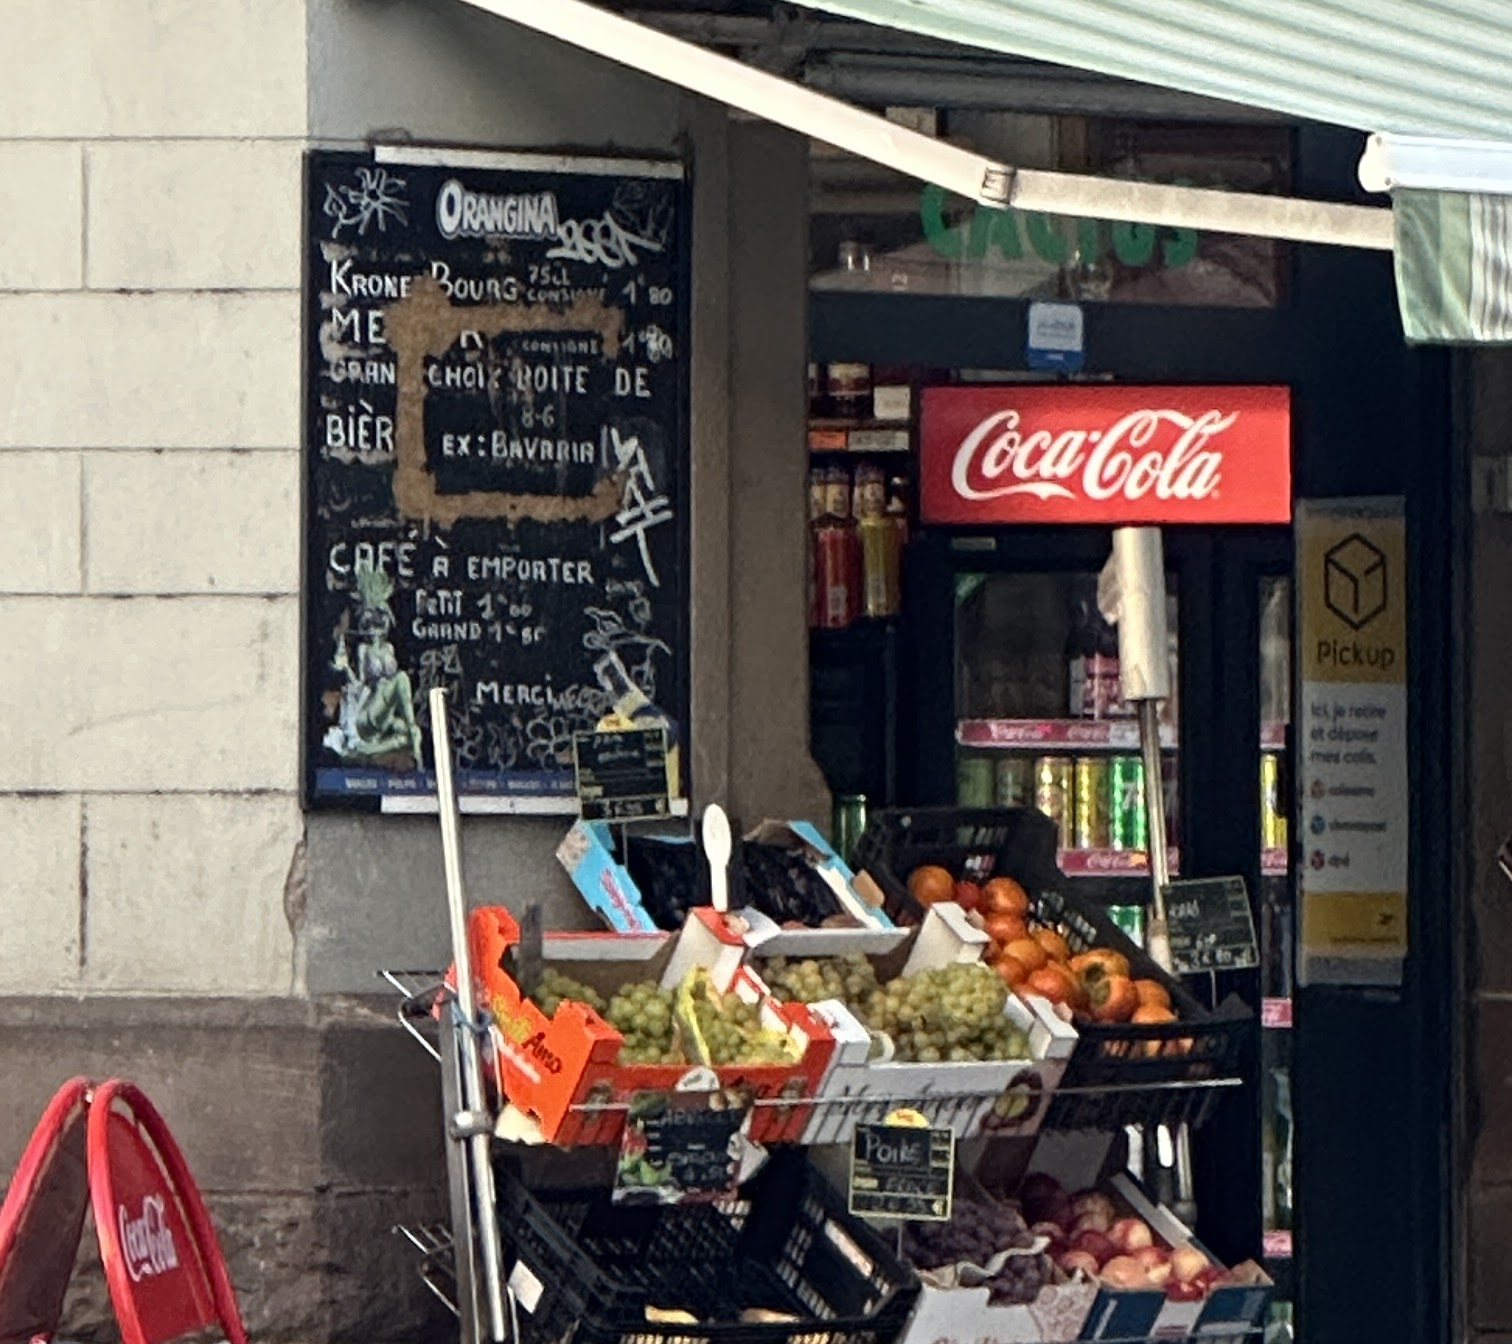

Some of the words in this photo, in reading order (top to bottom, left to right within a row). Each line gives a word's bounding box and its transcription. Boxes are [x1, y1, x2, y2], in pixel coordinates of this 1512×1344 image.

[436, 179, 559, 240] ORANGINA
[614, 367, 652, 398] DE
[950, 408, 1238, 501] Coca-Cola
[467, 556, 595, 585] EMPORTER
[1316, 638, 1395, 672] Pickup
[117, 1193, 180, 1283] Coca-Cola
